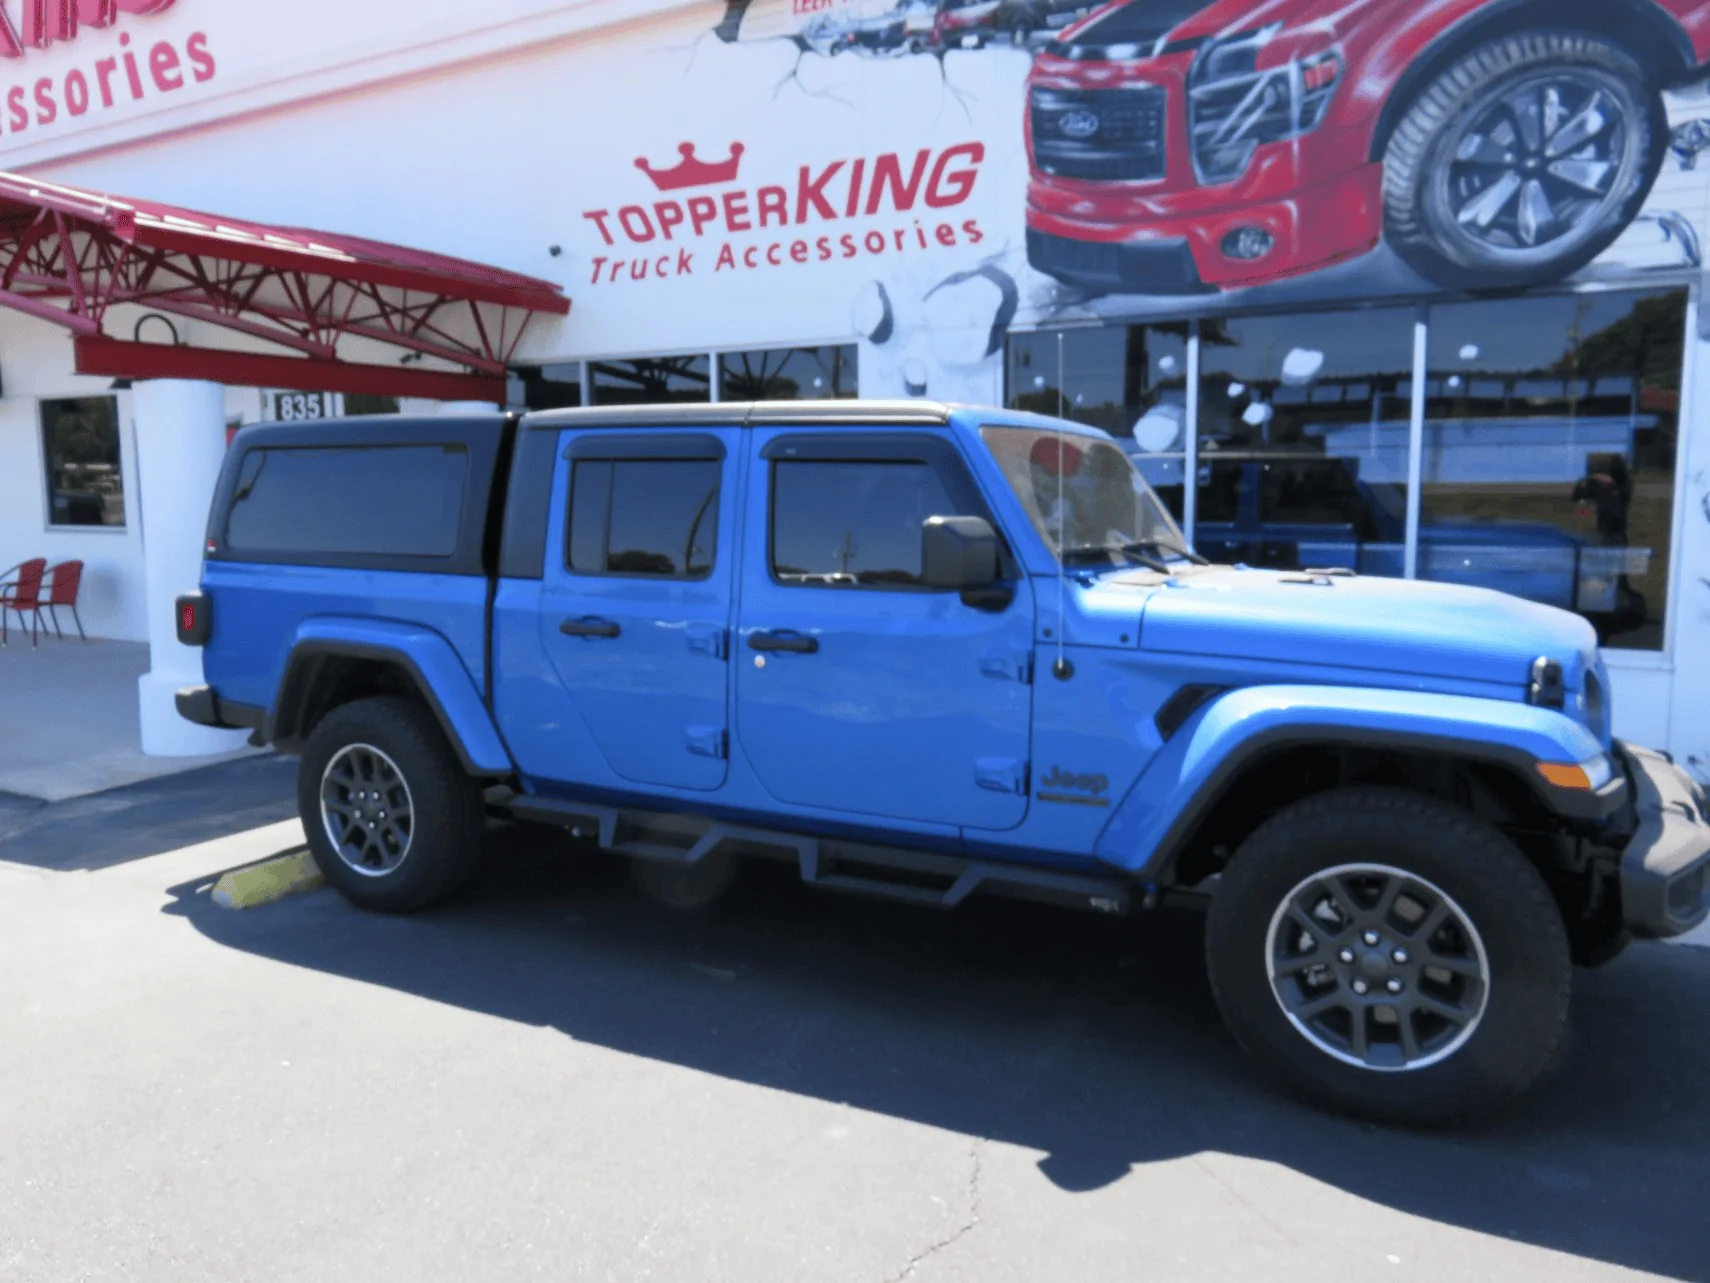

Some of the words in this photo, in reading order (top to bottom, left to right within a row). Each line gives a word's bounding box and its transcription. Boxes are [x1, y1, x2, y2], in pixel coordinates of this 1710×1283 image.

[0, 31, 216, 134] ssories
[590, 248, 694, 285] Truck
[714, 219, 984, 272] Accessories
[281, 393, 320, 420] 835
[1041, 765, 1109, 796] Jeep
